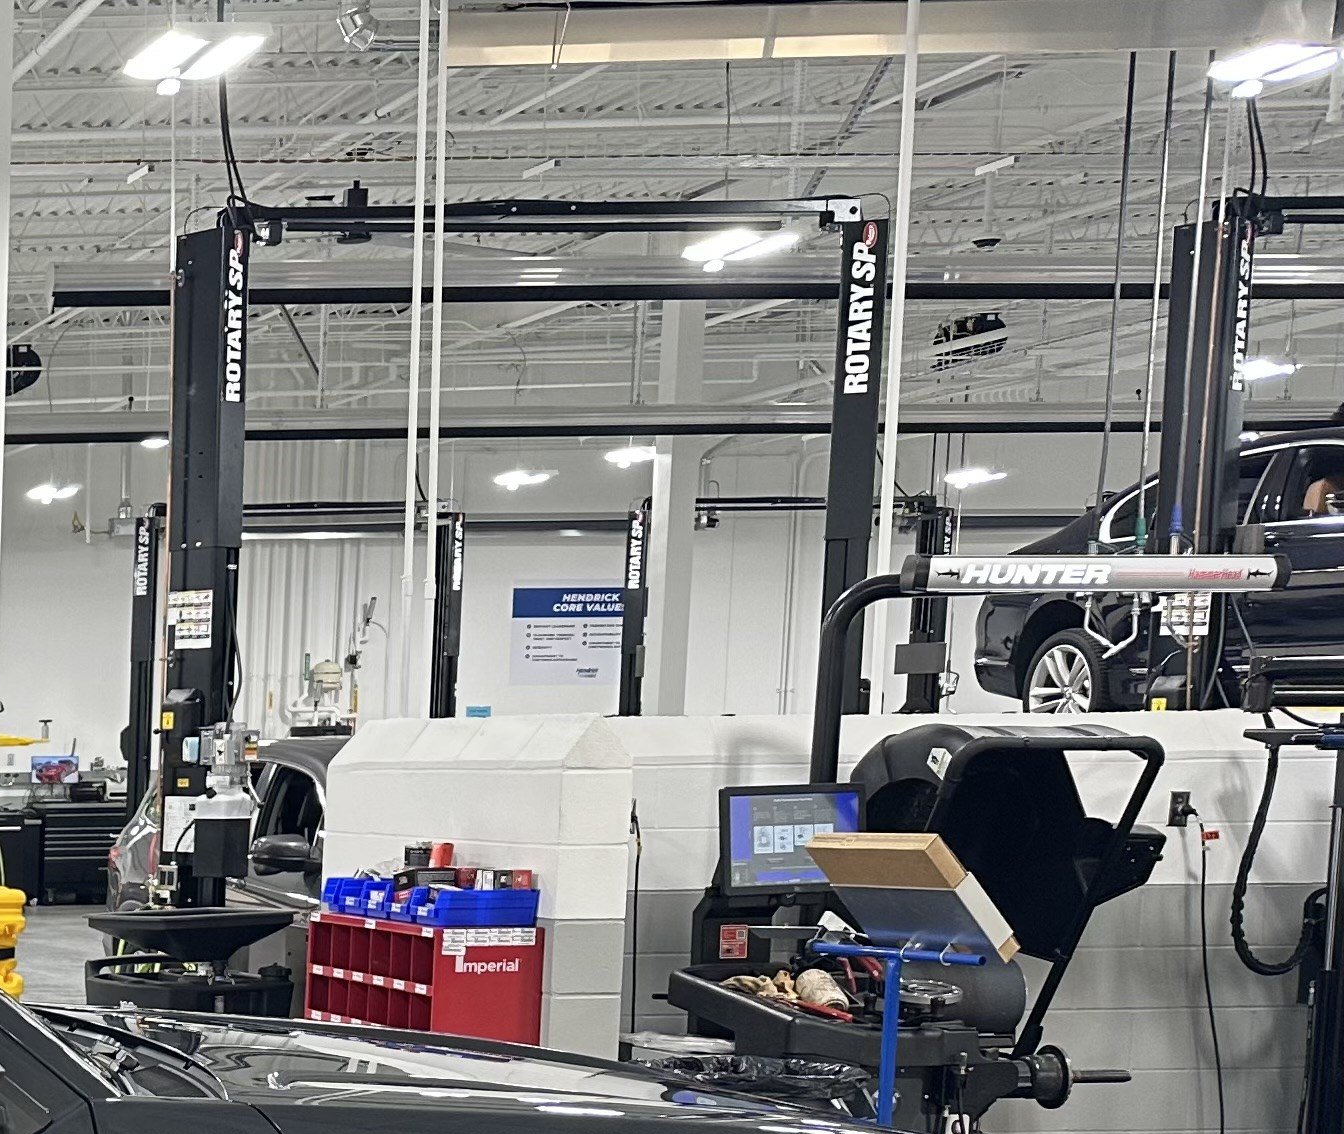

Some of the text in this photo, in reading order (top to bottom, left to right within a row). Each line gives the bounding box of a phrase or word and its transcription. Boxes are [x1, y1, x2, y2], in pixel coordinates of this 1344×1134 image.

[851, 242, 877, 282] SP
[225, 248, 244, 402] ROTARY SP
[843, 284, 874, 395] ROTARY
[1231, 239, 1250, 391] ROTARY SP
[135, 525, 150, 596] ROTARY SP
[627, 519, 644, 590] ROTARY SP
[961, 563, 1114, 586] HUNTER
[552, 603, 584, 612] CORE
[562, 593, 621, 602] HENDRICK
[454, 955, 520, 975] Imperial
